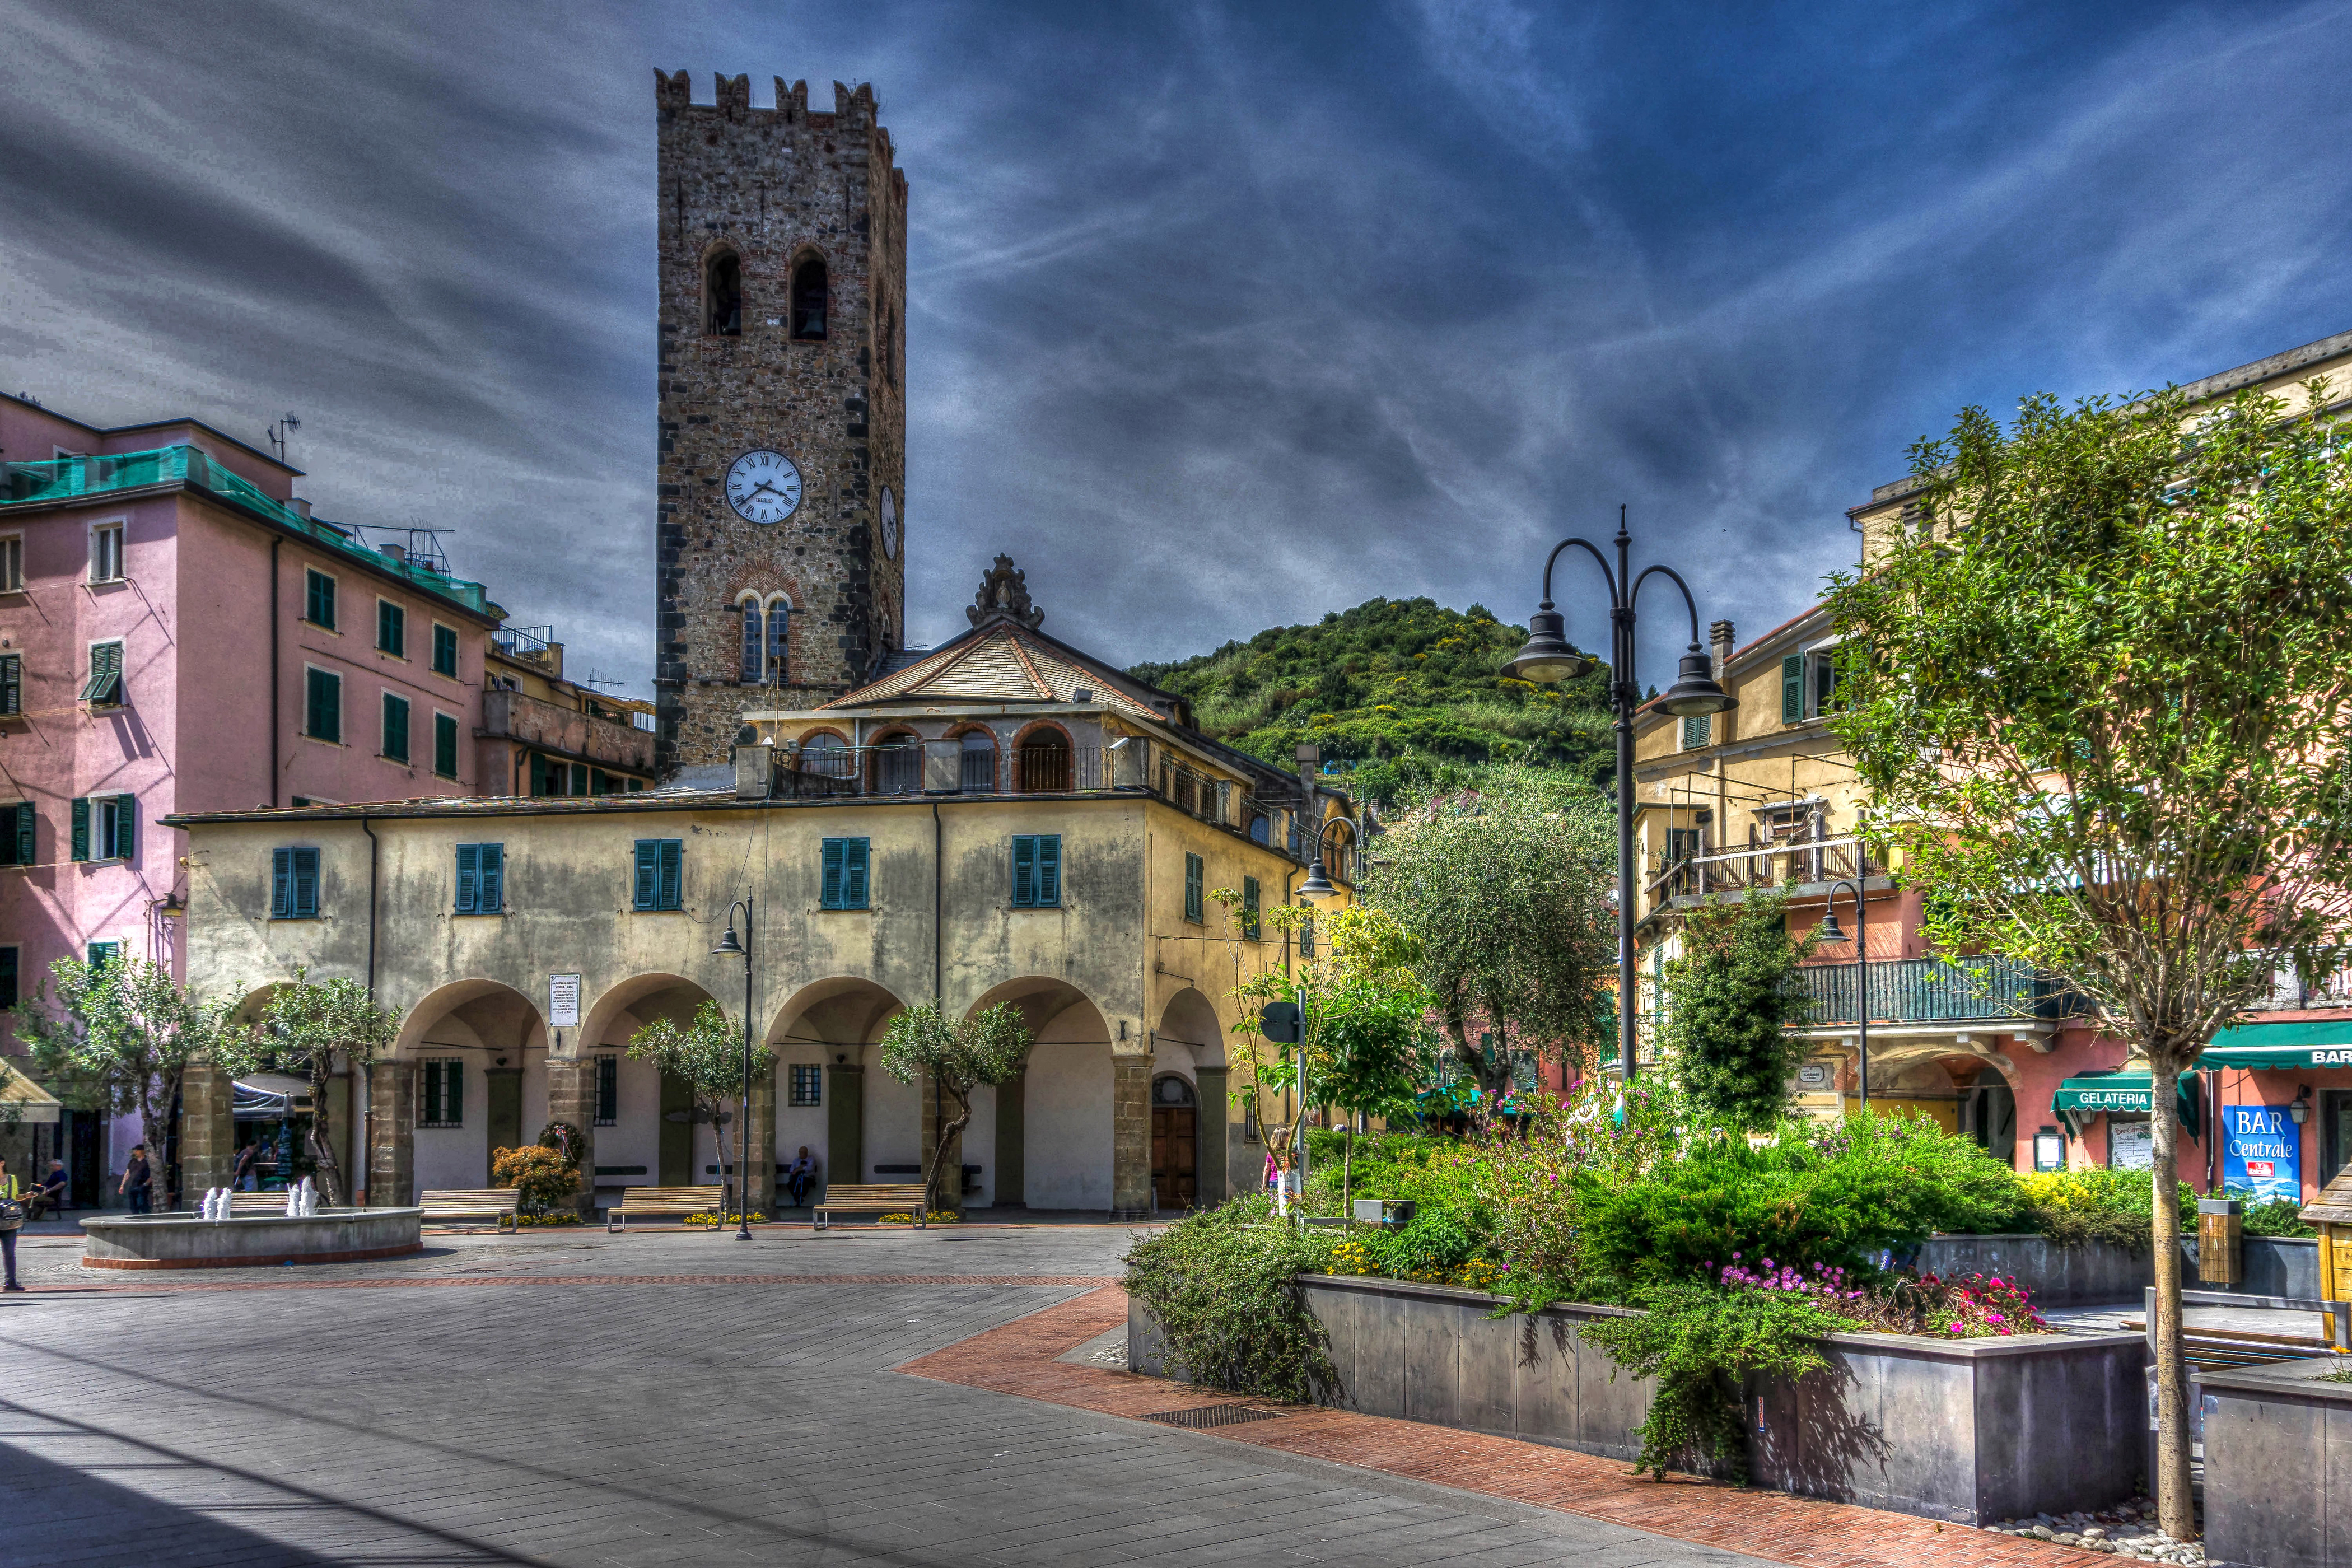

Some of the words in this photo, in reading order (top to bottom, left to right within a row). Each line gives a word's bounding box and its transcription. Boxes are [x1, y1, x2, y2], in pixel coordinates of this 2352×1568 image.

[2312, 1051, 2352, 1063] BAR
[2080, 1093, 2148, 1104] GELATERIA
[2236, 1111, 2286, 1136] BAR
[2230, 1137, 2293, 1158] Centrale
